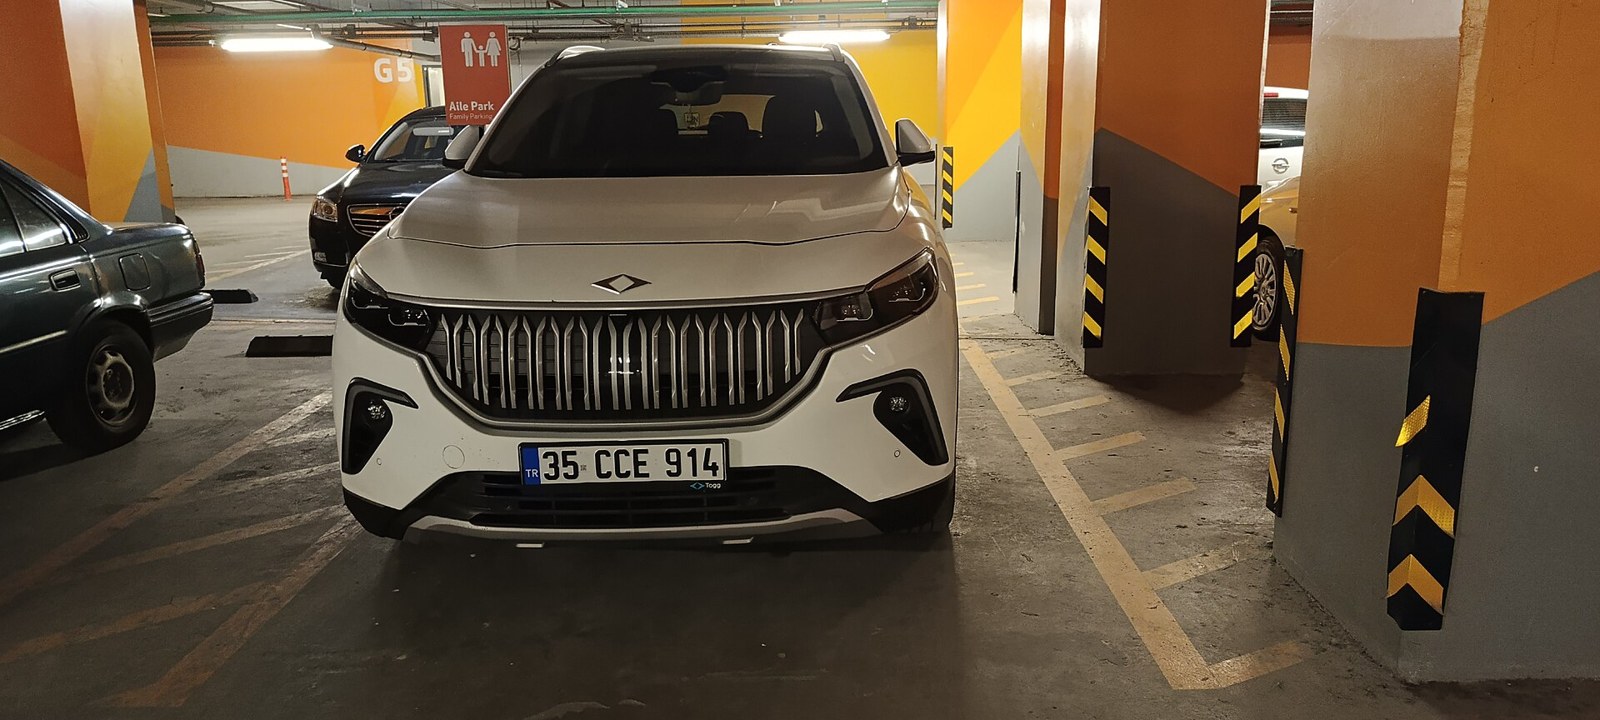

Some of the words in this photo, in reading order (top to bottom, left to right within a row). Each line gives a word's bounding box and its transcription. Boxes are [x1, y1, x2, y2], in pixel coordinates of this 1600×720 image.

[449, 101, 469, 111] Aile
[471, 101, 494, 111] Park
[449, 112, 469, 121] Family
[542, 450, 579, 481] 35
[594, 448, 650, 479] CCE
[665, 447, 719, 478] 914
[525, 468, 539, 478] TR
